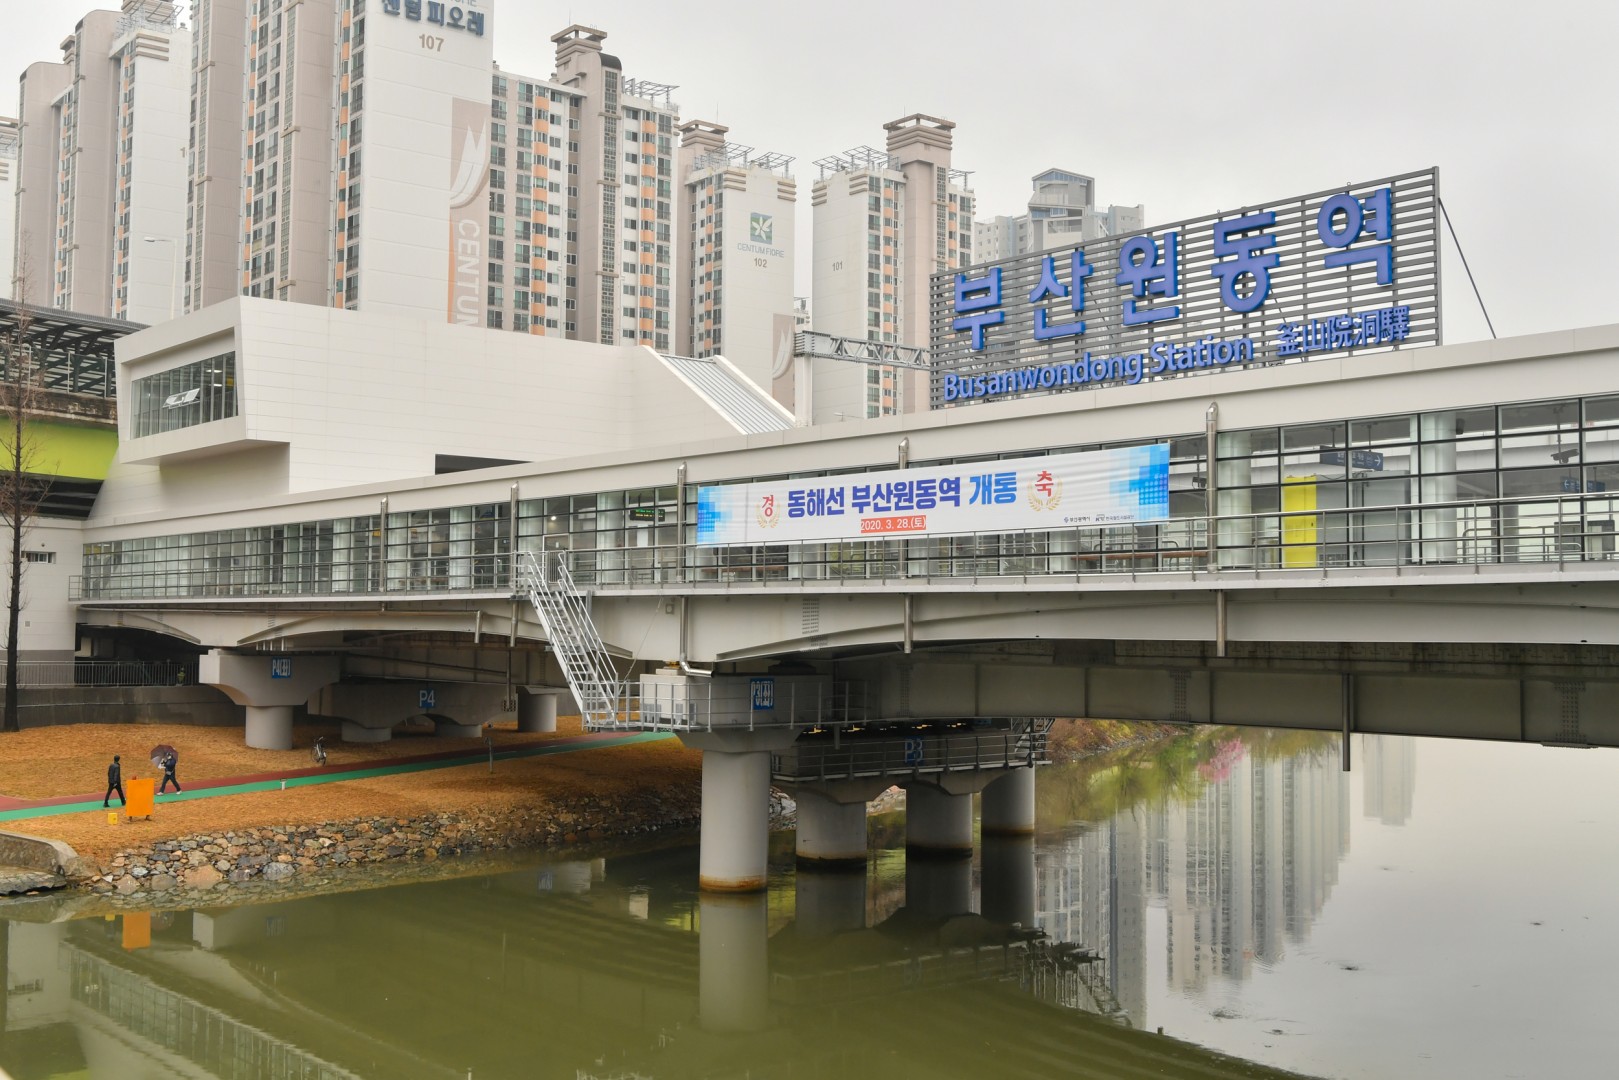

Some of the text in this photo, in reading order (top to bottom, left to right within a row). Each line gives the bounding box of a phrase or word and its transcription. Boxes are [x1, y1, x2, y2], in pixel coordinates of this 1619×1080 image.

[419, 33, 444, 52] 107
[737, 243, 765, 255] CENTUM
[754, 258, 767, 268] 102
[832, 261, 843, 271] 101
[952, 188, 1393, 350] 부산원동역
[943, 305, 1410, 401] Busanwondong Station 釜山院洞驛
[761, 470, 1054, 518] 경 동해선 부산원동역 개통 축
[419, 690, 435, 707] P4
[904, 738, 924, 763] P3
